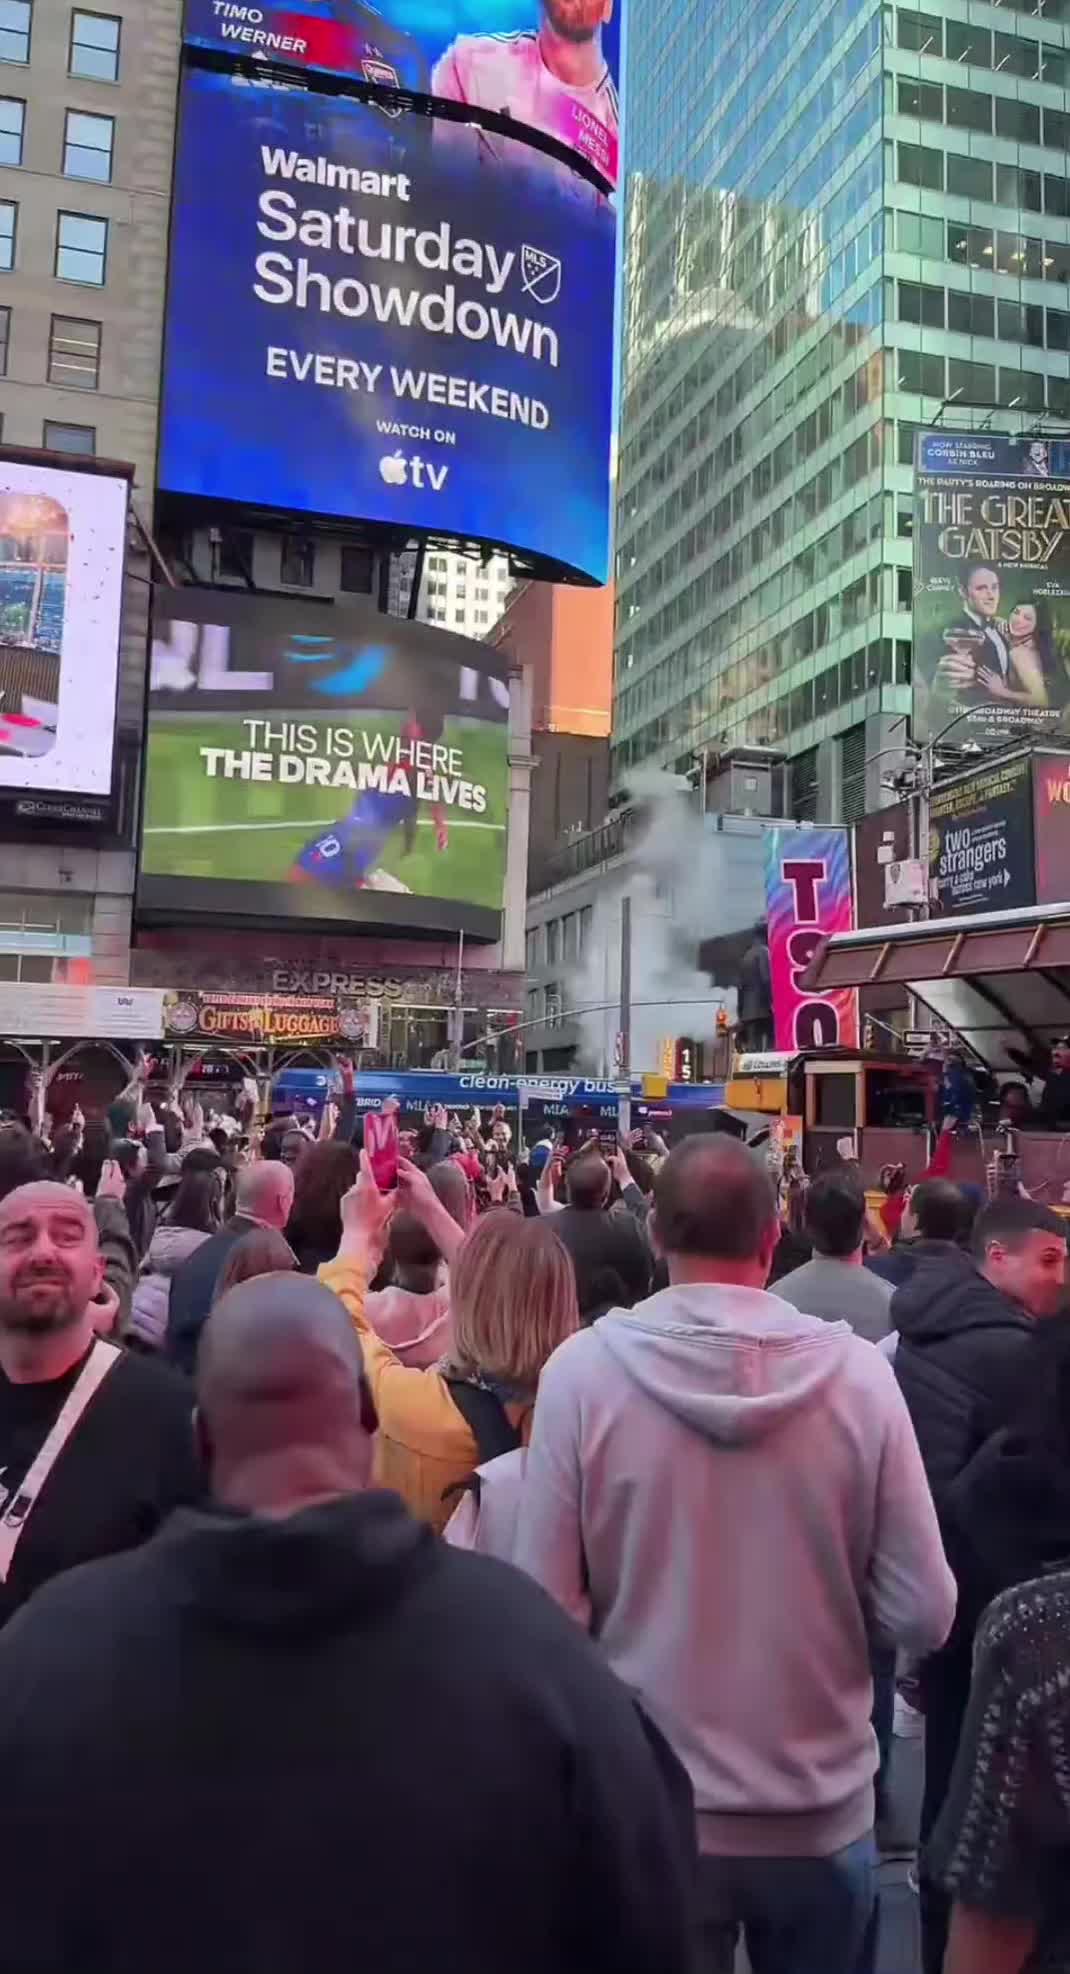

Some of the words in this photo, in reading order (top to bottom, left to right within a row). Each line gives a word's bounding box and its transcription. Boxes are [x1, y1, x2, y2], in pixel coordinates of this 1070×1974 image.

[212, 1, 264, 24] TIMO
[220, 23, 308, 54] WERNER
[570, 102, 608, 144] LIONEL
[260, 145, 411, 202] Walmart
[256, 190, 515, 294] Saturday
[524, 248, 548, 269] MLS
[252, 251, 559, 368] Showdown
[265, 345, 384, 395] EVERY
[389, 365, 550, 430] WEEKEND
[376, 419, 431, 442] WATCH
[433, 428, 456, 446] ON
[409, 453, 449, 491] tv
[917, 490, 974, 526] THE
[938, 525, 1064, 562] GATSBY
[243, 719, 318, 756] THIS
[325, 726, 354, 757] IS
[362, 730, 463, 778] WHERE
[200, 747, 272, 782] THE
[278, 755, 410, 797] DRAMA
[415, 770, 487, 813] LIVES
[939, 837, 1007, 876] strangers
[944, 828, 971, 852] two
[272, 968, 402, 999] EXPRESS
[459, 1072, 580, 1096] clean-energy
[584, 1079, 617, 1093] bus
